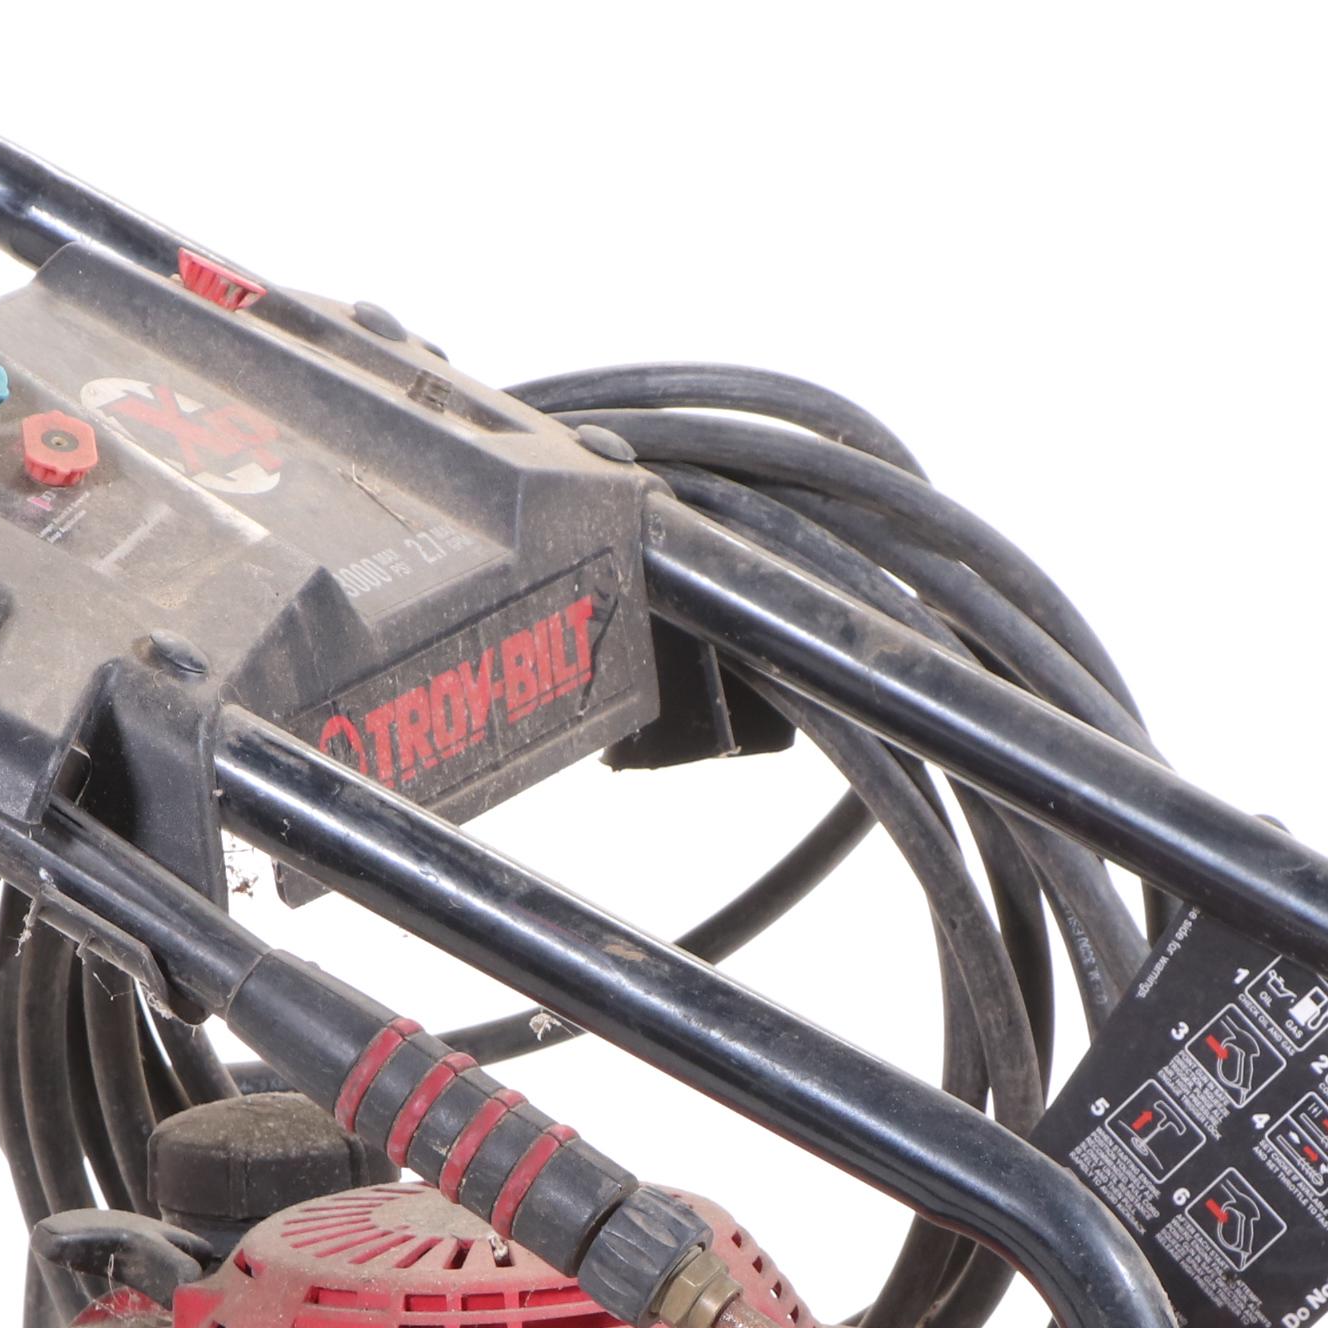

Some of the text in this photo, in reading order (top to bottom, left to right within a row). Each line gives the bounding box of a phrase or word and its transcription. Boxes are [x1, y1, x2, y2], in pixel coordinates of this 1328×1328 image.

[364, 595, 593, 788] TROY-BILT
[1135, 918, 1192, 998] side for warnings.
[1233, 967, 1249, 984] 1
[1170, 1021, 1189, 1040] 3
[1238, 993, 1295, 1056] CHECK OIL AND GAS
[1259, 990, 1303, 1038] OIL GAS
[1162, 1065, 1174, 1077] AIR
[1178, 1049, 1229, 1105] POINT GUN IN SAFE
[1090, 1097, 1109, 1115] 5
[1157, 1069, 1221, 1140] ENGAGE TRIGGER LOCK
[1202, 1087, 1229, 1116] SQUEEZE
[1211, 1108, 1223, 1122] ALL
[1251, 1113, 1270, 1129] 4
[1090, 1131, 1153, 1200] POSITION YOURSELF AS
[1095, 1126, 1113, 1146] WHEN
[1111, 1144, 1140, 1174] STARTING
[1068, 1150, 1145, 1234] RAPIDLY TO AVOID KICKBACK
[1074, 1146, 1082, 1154] IS
[1094, 1168, 1108, 1182] AND
[1107, 1181, 1123, 1199] THEN
[1120, 1196, 1135, 1215] PULL
[1079, 1140, 1154, 1219] SLOWLY UNTIL RESISTANCE
[1127, 1182, 1142, 1200] PULL
[1141, 1198, 1159, 1217] CORD
[1172, 1187, 1190, 1205] 6
[1252, 1145, 1267, 1160] AND
[1265, 1159, 1279, 1172] SET
[1277, 1171, 1308, 1206] THROTTLE
[1307, 1203, 1317, 1214] TO
[1258, 1139, 1273, 1153] SET
[1270, 1152, 1292, 1175] CHOKE
[1296, 1181, 1328, 1215] AVAILABLE
[1155, 1232, 1181, 1260] RELEASE
[1179, 1260, 1195, 1276] HIGH
[1175, 1213, 1195, 1234] AFTER
[1193, 1232, 1211, 1251] EACH
[1190, 1239, 1212, 1263] ENGINE
[1160, 1227, 1249, 1325] SQUEEZE SPRAY GUN TRIGGER TO
[1165, 1222, 1257, 1323] POINT GUN IN SAFE DIRECTION AND
